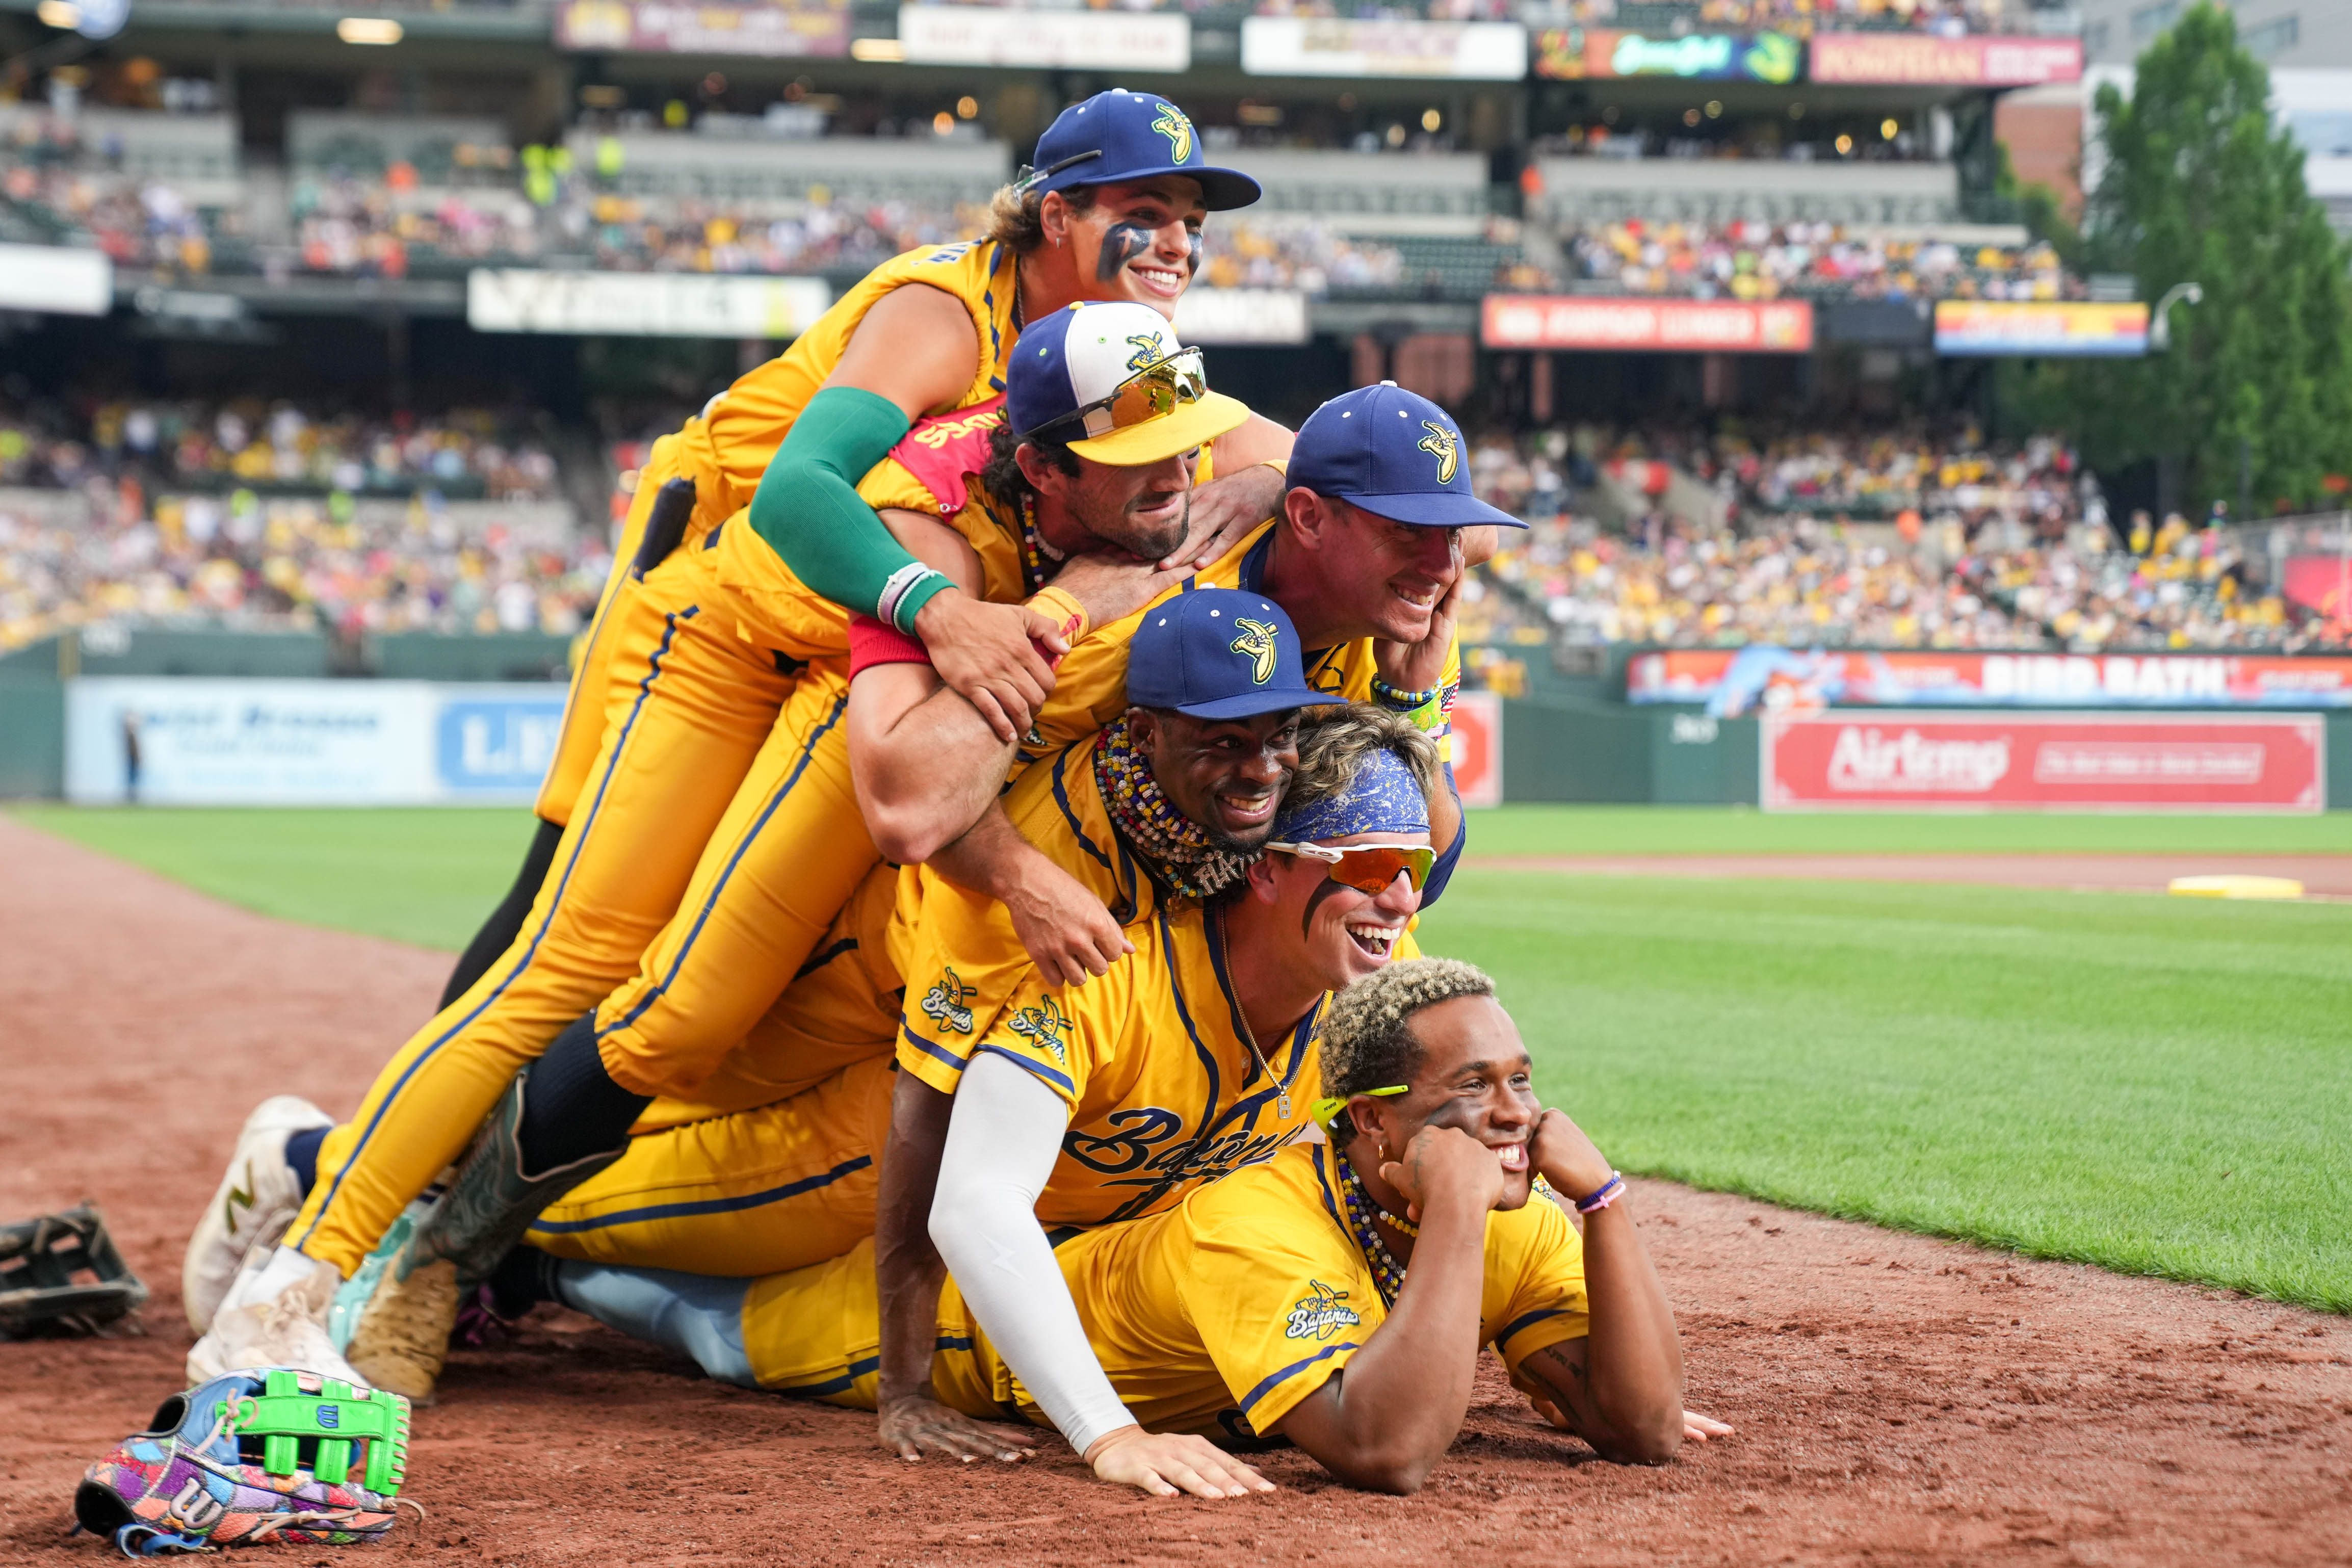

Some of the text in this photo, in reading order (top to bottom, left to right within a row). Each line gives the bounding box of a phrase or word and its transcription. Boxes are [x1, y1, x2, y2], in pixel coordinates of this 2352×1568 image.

[1981, 657, 2099, 697] BIRD
[2104, 657, 2227, 697] BATH
[1829, 726, 2009, 788] Airtemp
[1286, 1309, 1360, 1338] Bananas
[170, 1476, 224, 1529] W
